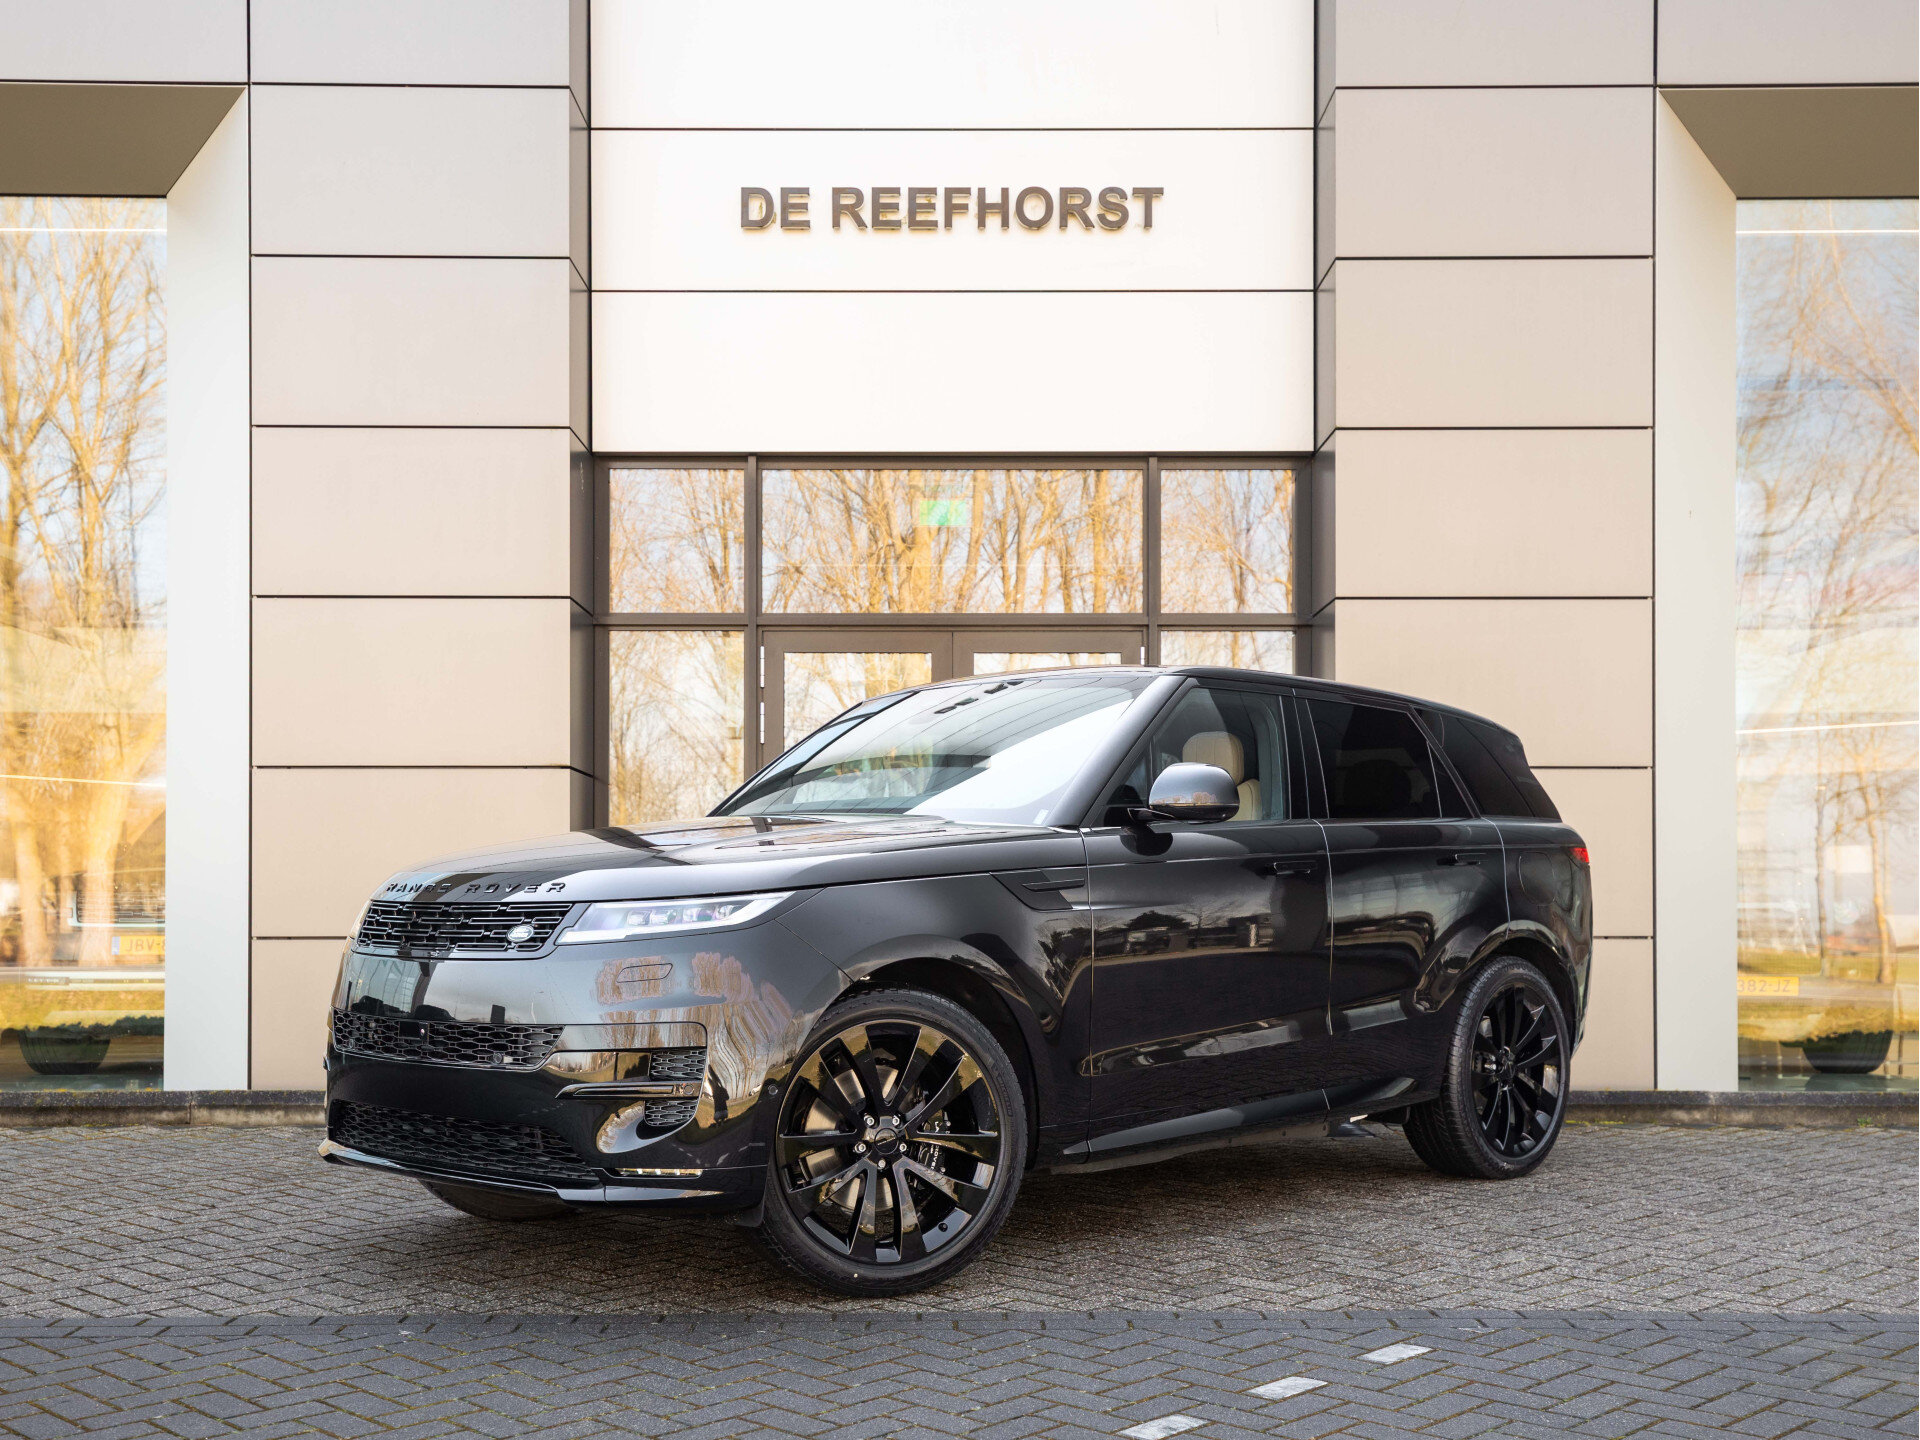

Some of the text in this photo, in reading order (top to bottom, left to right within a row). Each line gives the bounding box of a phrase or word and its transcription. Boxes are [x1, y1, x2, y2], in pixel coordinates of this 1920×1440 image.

[740, 186, 1165, 231] DE REEFHORST
[385, 882, 567, 894] RANGE ROVER
